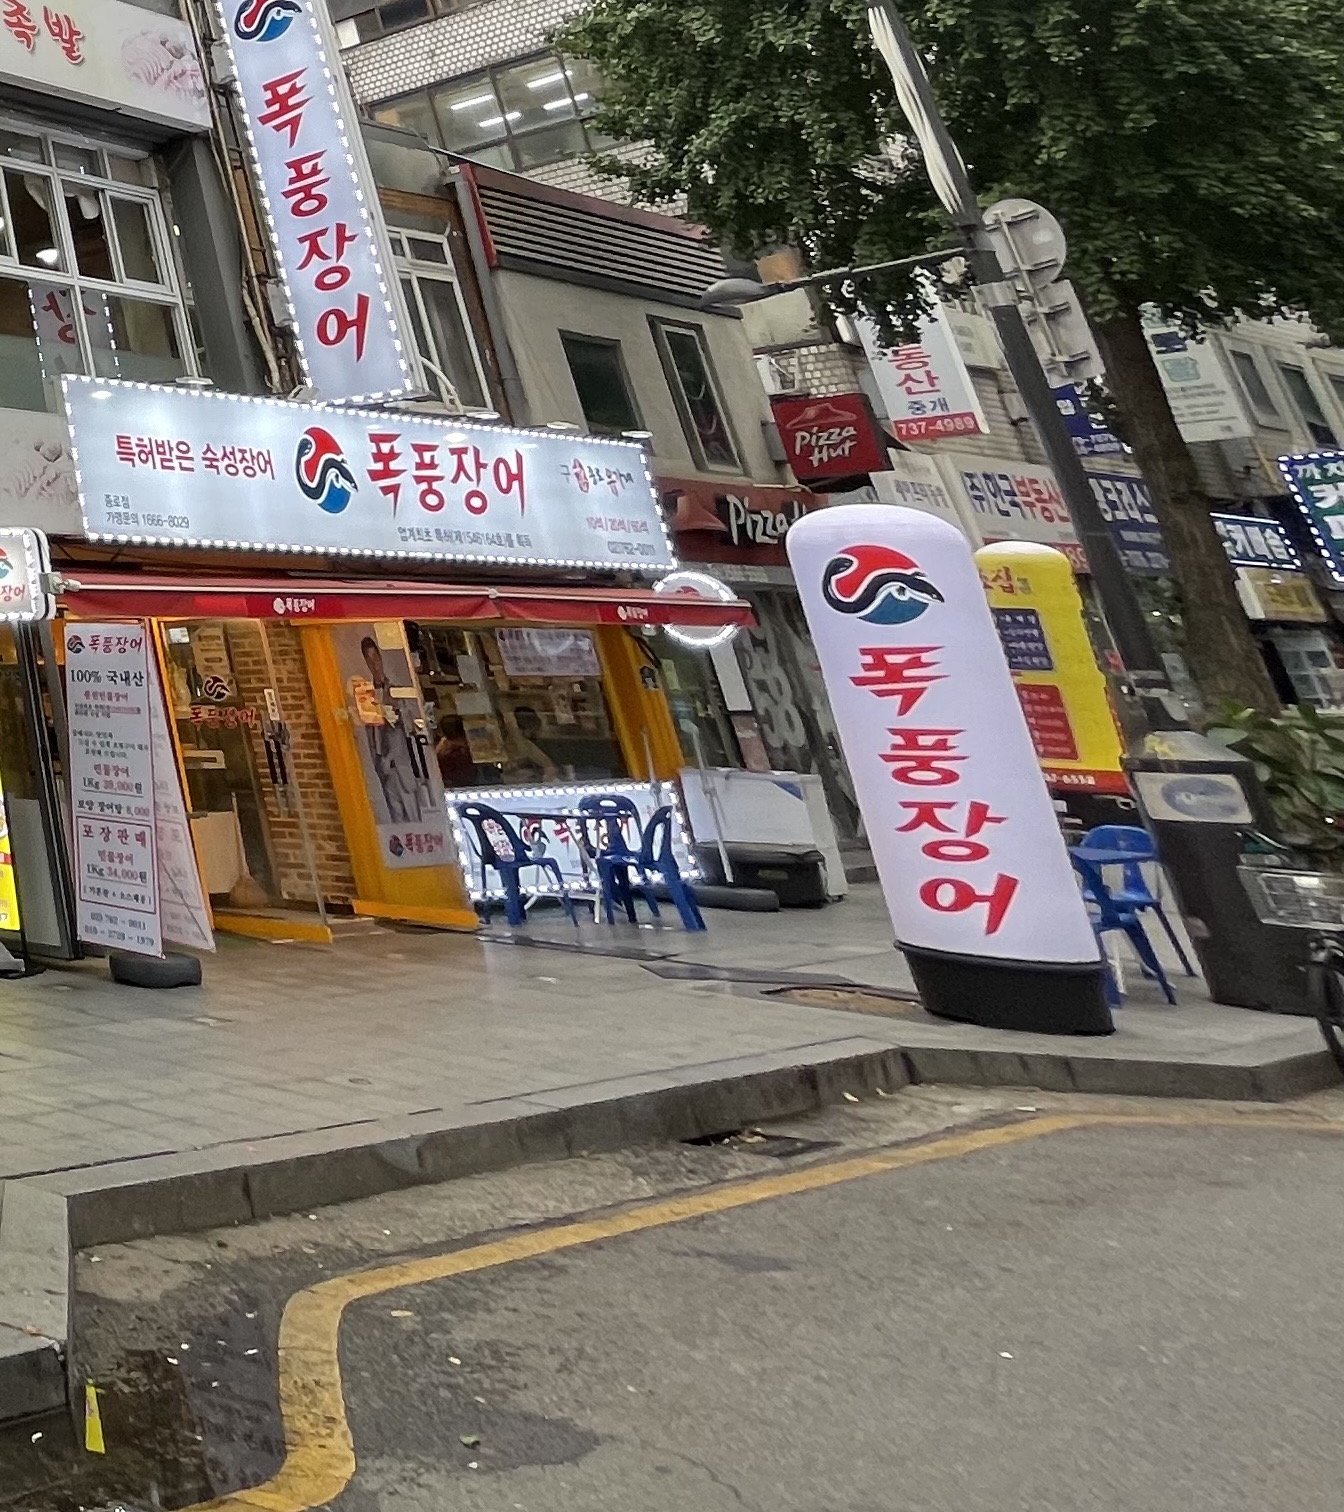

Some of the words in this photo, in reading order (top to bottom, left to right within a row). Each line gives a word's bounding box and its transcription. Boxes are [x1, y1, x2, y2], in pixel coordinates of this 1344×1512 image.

[257, 67, 370, 362] 폭풍장어
[795, 425, 858, 456] Pizza
[897, 414, 976, 437] 737-4989
[116, 434, 196, 473] 특허받은
[201, 442, 275, 481] 숙성장어
[809, 441, 858, 468] Hut
[366, 432, 526, 519] 폭풍장어
[725, 494, 788, 545] Pizza
[88, 634, 143, 654] 폭풍장어
[70, 669, 102, 684] 100%
[106, 669, 145, 687] 국내산
[190, 704, 257, 728] 폭풍장어
[849, 644, 1022, 936] 폭풍장어
